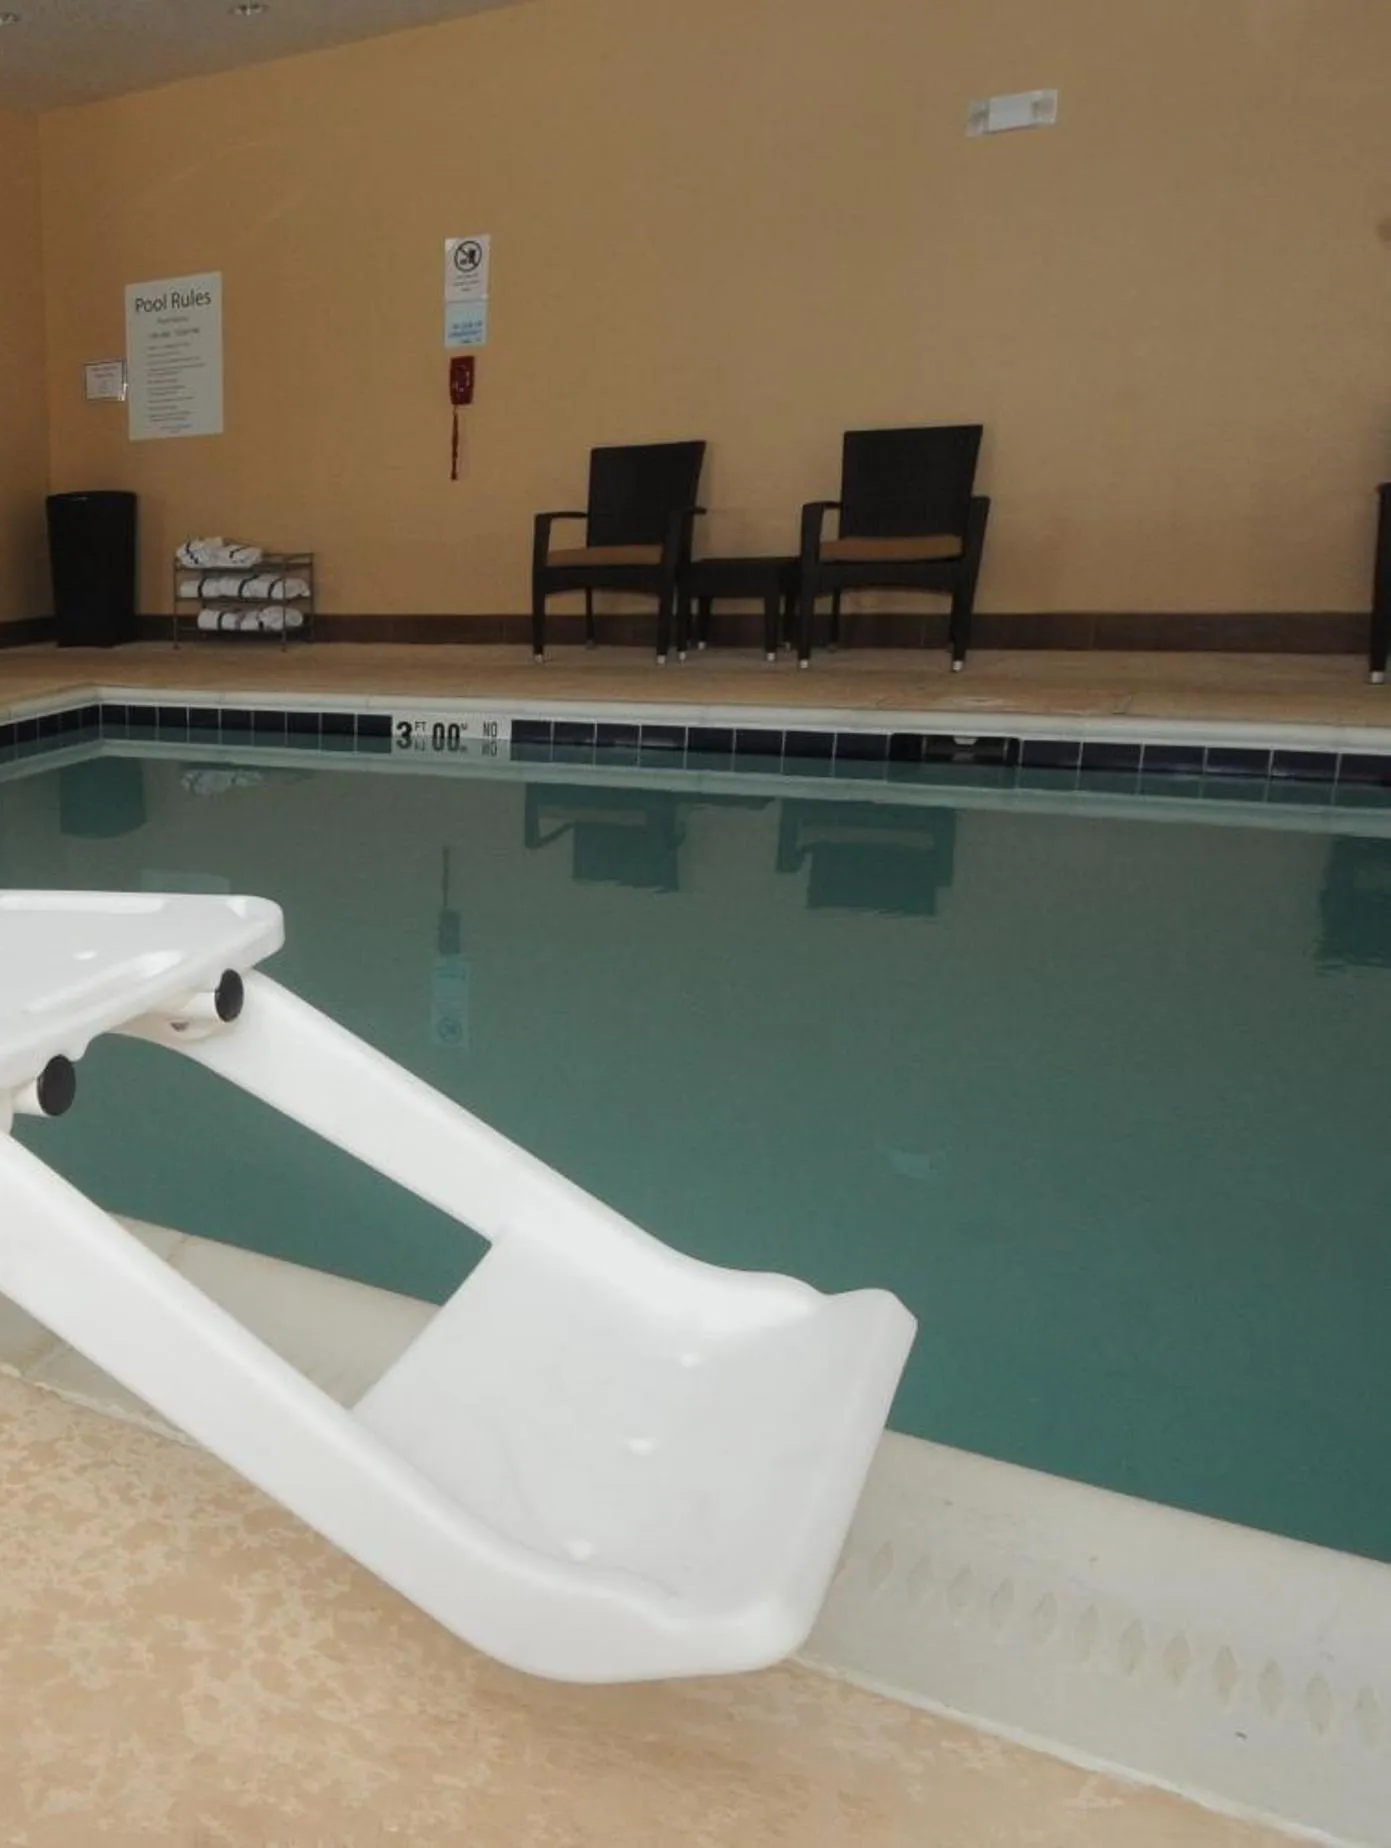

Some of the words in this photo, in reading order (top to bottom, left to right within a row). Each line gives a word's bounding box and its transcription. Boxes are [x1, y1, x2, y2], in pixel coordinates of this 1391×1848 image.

[135, 294, 167, 313] Pool
[172, 288, 212, 309] Rules
[396, 721, 412, 749] 3
